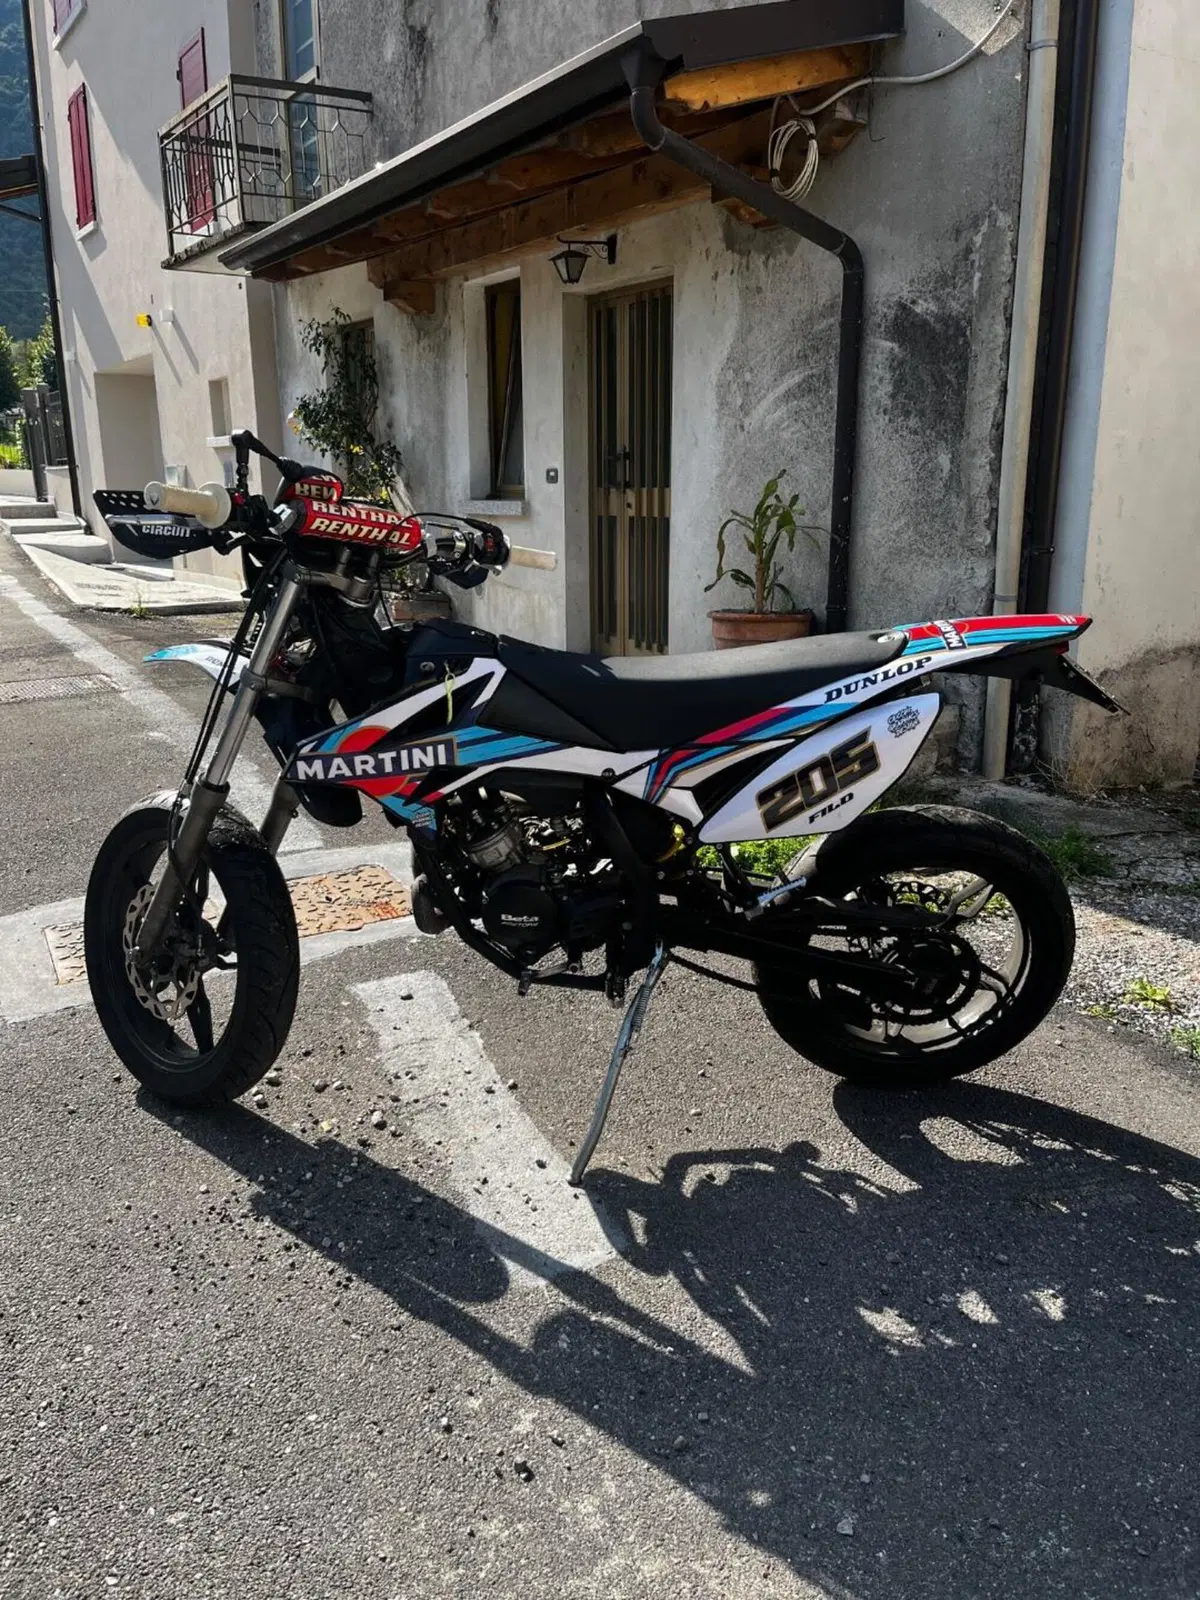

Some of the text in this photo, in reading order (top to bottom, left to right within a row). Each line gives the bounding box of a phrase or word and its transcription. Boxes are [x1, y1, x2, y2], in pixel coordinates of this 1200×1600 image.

[312, 501, 413, 528] RENTHAL
[142, 525, 191, 538] CIRCUIT
[310, 518, 413, 544] RENTHAL
[824, 656, 932, 704] DUNLOP
[296, 744, 447, 780] MARTINI
[755, 726, 881, 833] 205
